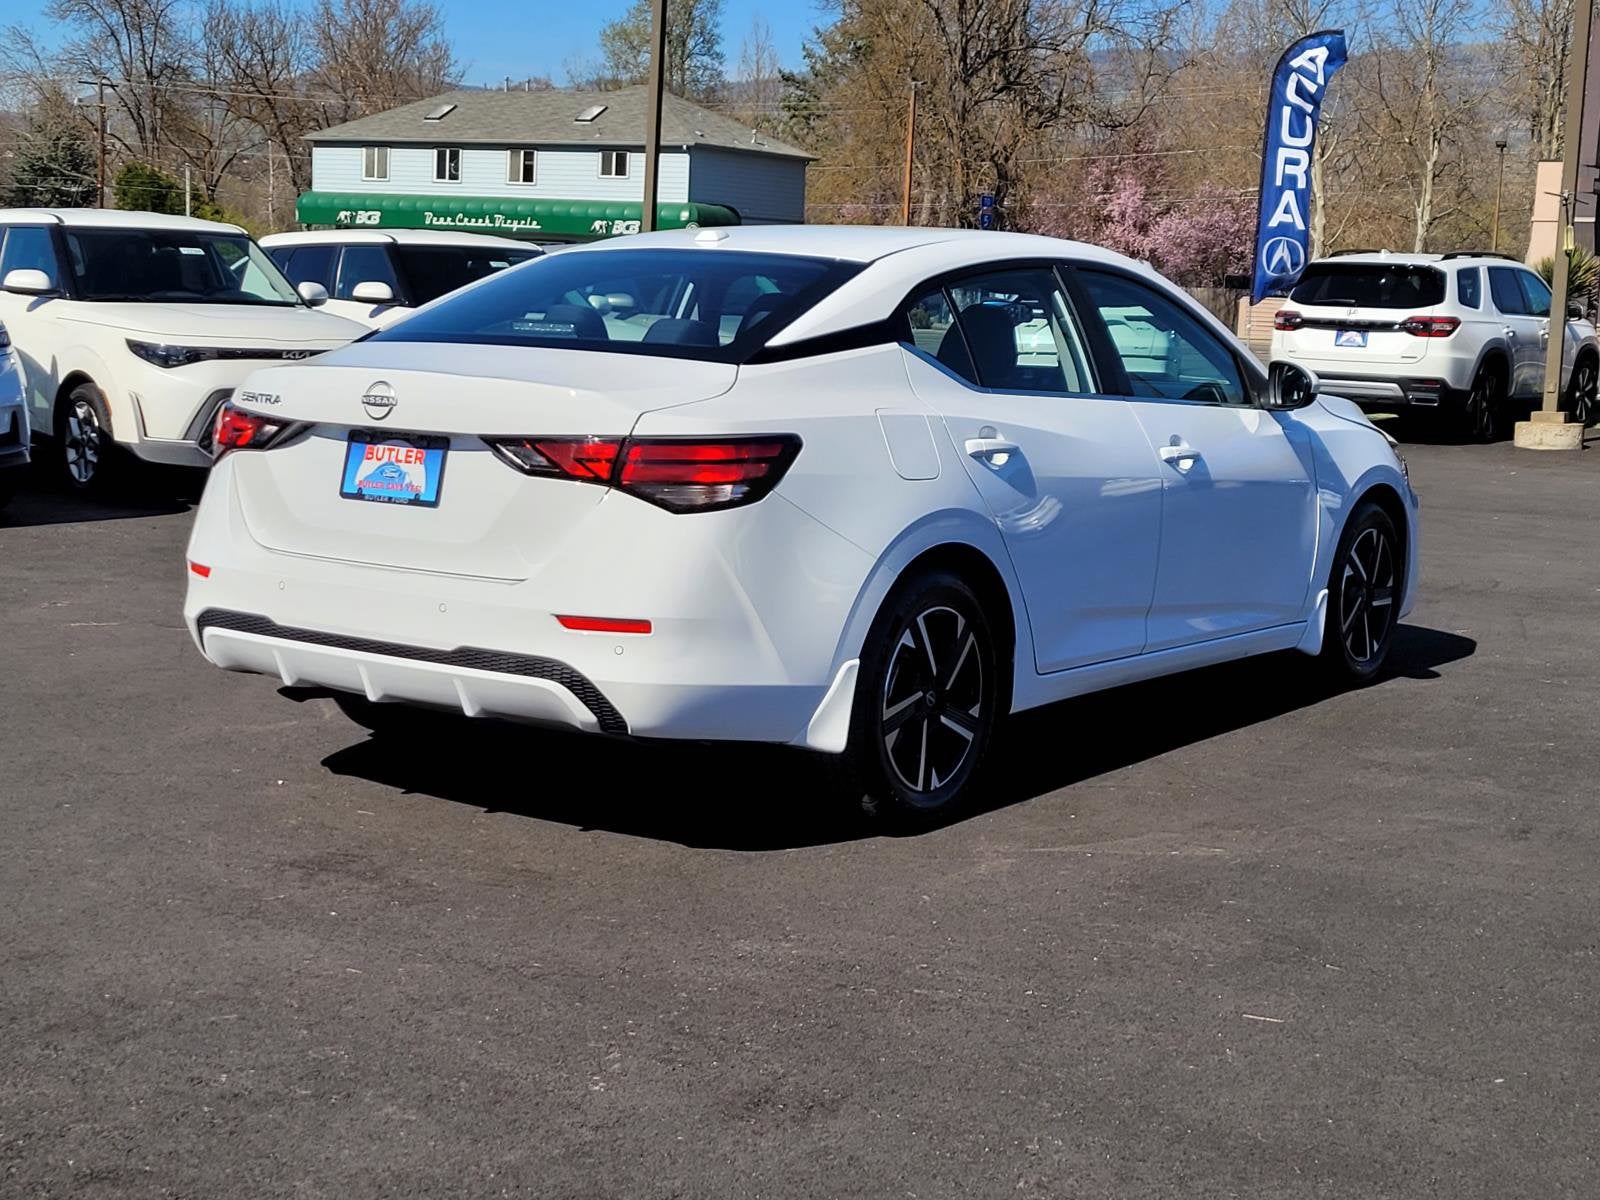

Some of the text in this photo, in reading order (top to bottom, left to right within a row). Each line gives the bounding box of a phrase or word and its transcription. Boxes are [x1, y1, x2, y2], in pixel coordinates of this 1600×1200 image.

[1268, 45, 1330, 231] ACURA
[424, 211, 542, 231] Bear Creek Bicycle
[241, 391, 282, 404] SENTRA
[361, 395, 398, 407] NISSAN
[365, 444, 425, 464] BUTLER
